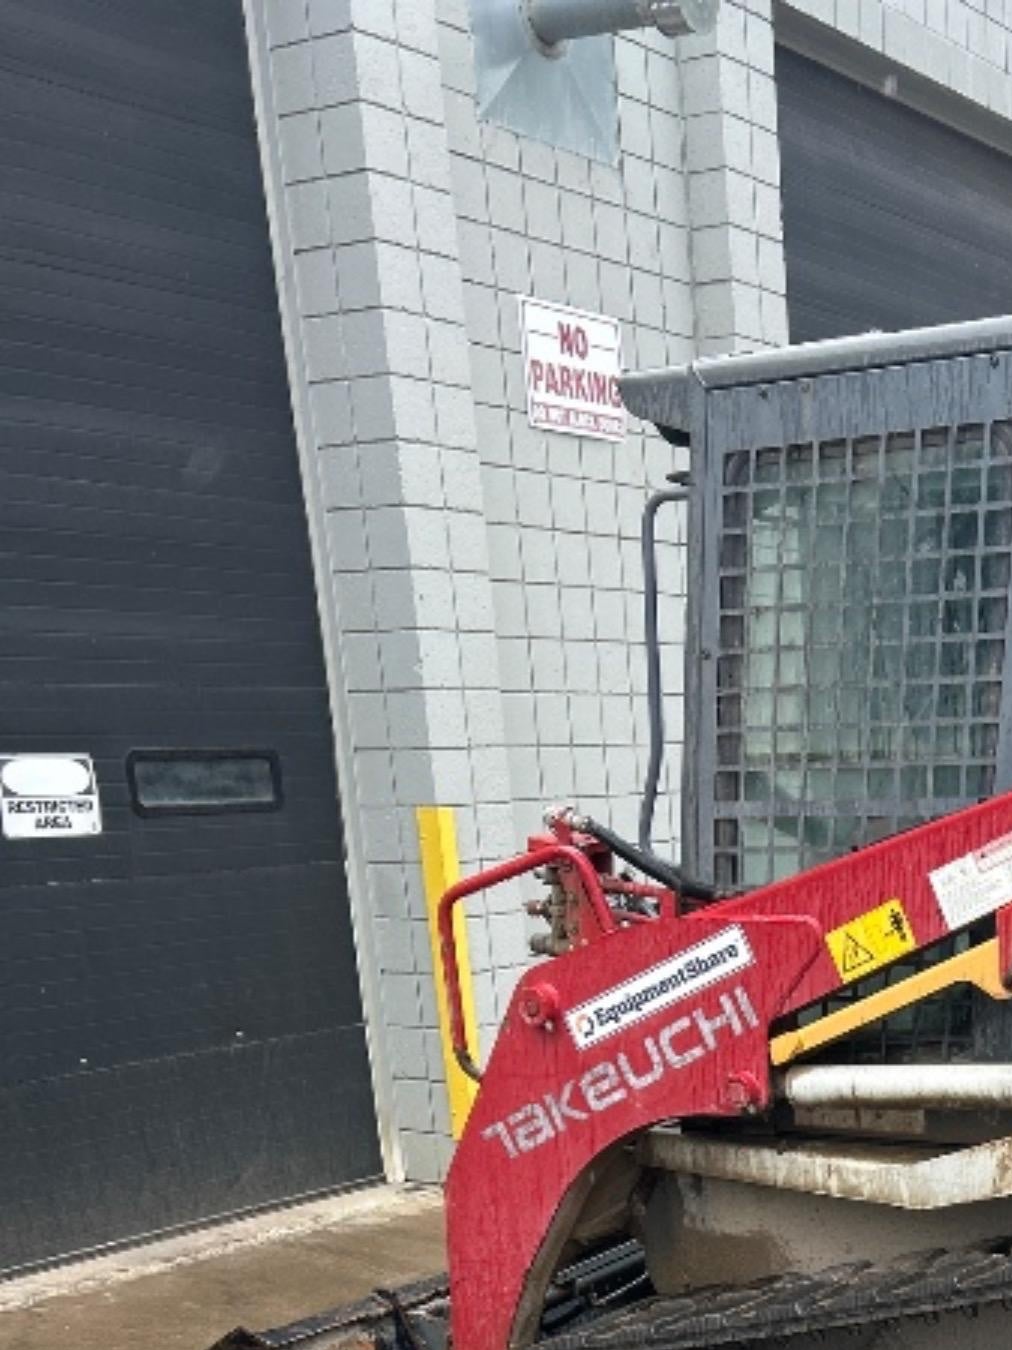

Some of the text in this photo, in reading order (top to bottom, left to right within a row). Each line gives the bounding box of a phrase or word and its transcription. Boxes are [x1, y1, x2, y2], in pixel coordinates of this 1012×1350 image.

[557, 319, 589, 360] NO
[529, 358, 622, 409] PARKING
[592, 942, 740, 1028] EquipmentShare
